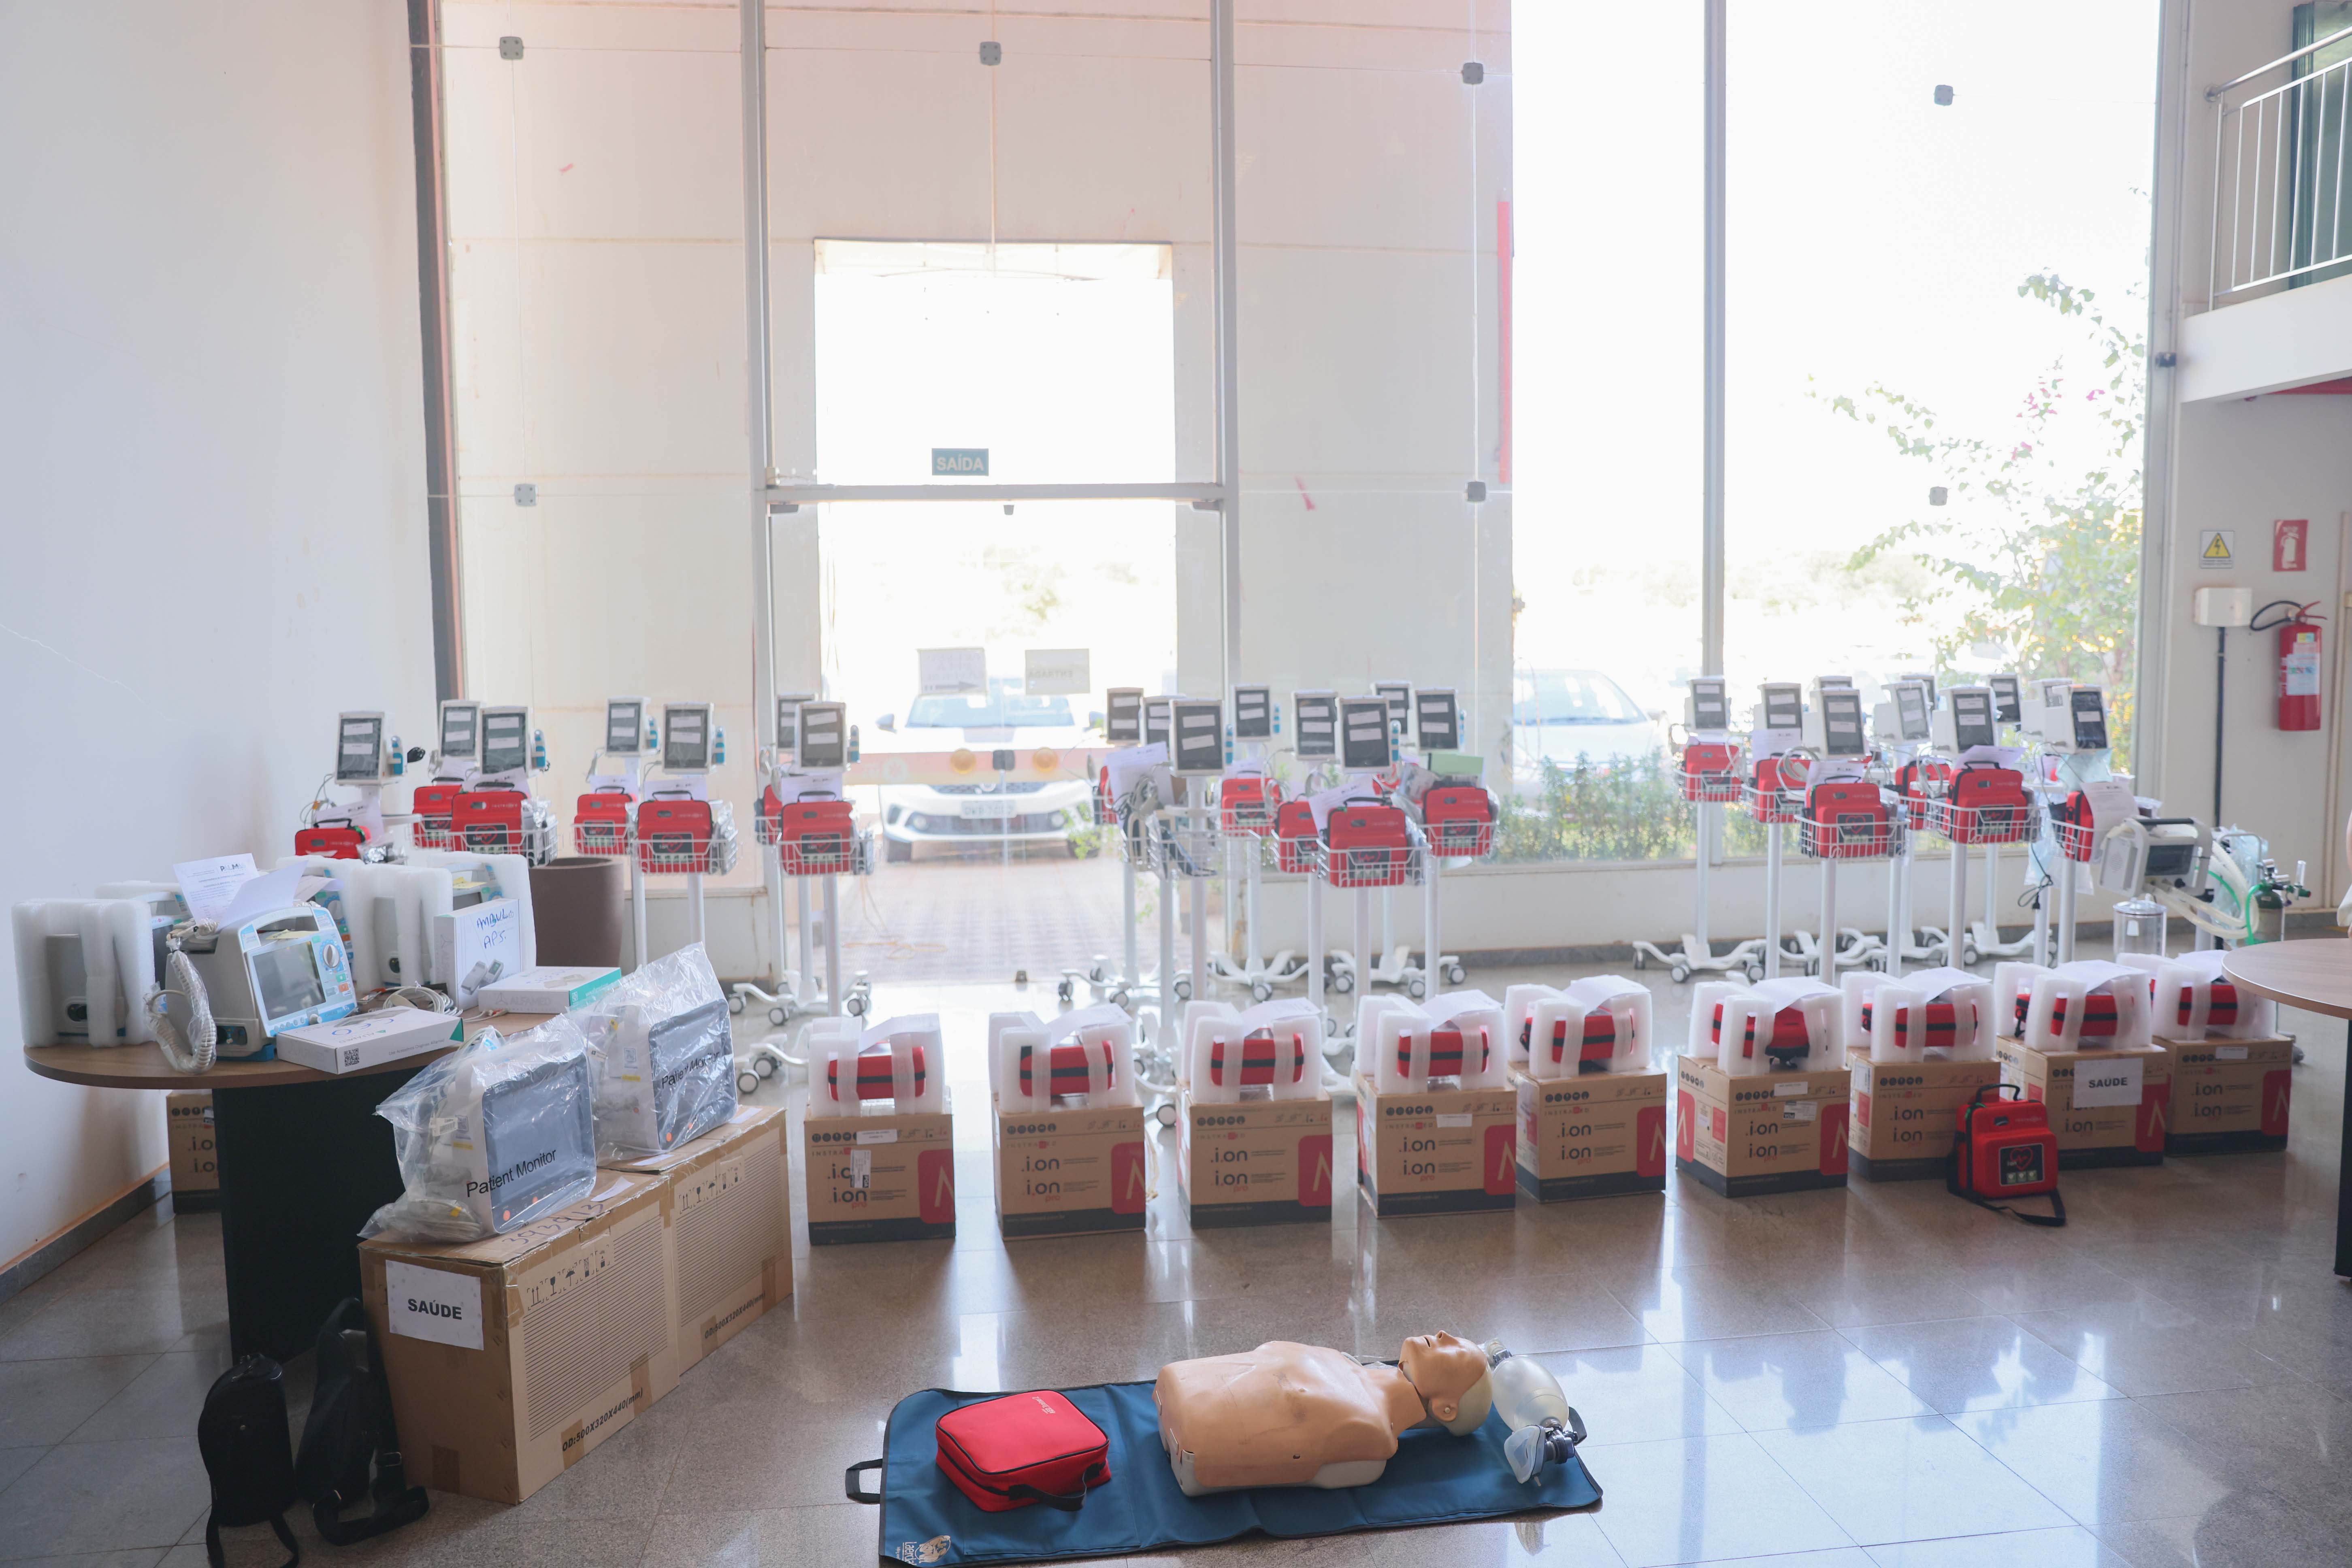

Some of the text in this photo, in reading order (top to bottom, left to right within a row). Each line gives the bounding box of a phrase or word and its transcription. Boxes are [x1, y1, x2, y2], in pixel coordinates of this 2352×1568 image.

[937, 454, 984, 471] SAÍDA
[466, 1150, 557, 1197] Patient Monitor
[408, 1298, 462, 1320] SAÚDE
[562, 1387, 643, 1452] OD:500X320X440(mm)
